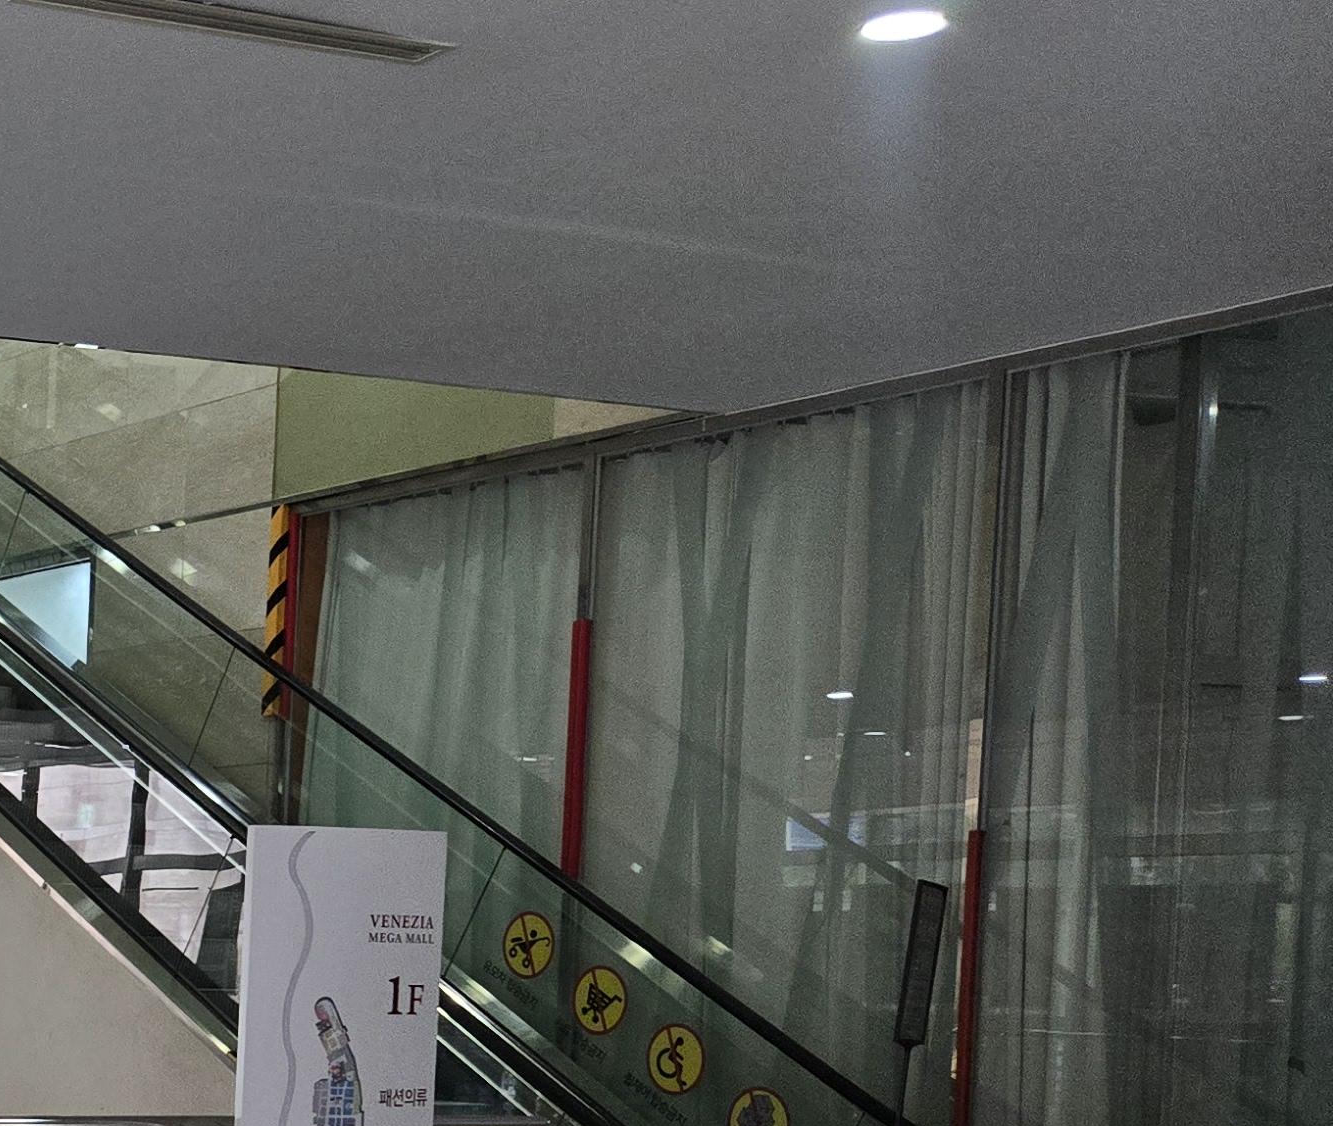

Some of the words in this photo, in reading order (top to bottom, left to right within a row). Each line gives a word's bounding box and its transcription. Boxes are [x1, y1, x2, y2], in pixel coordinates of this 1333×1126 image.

[369, 914, 434, 931] VENEZIA
[368, 932, 403, 944] MEGA
[406, 932, 434, 945] MALL
[388, 975, 425, 1016] 1F
[379, 1087, 428, 1108] 패션의류
